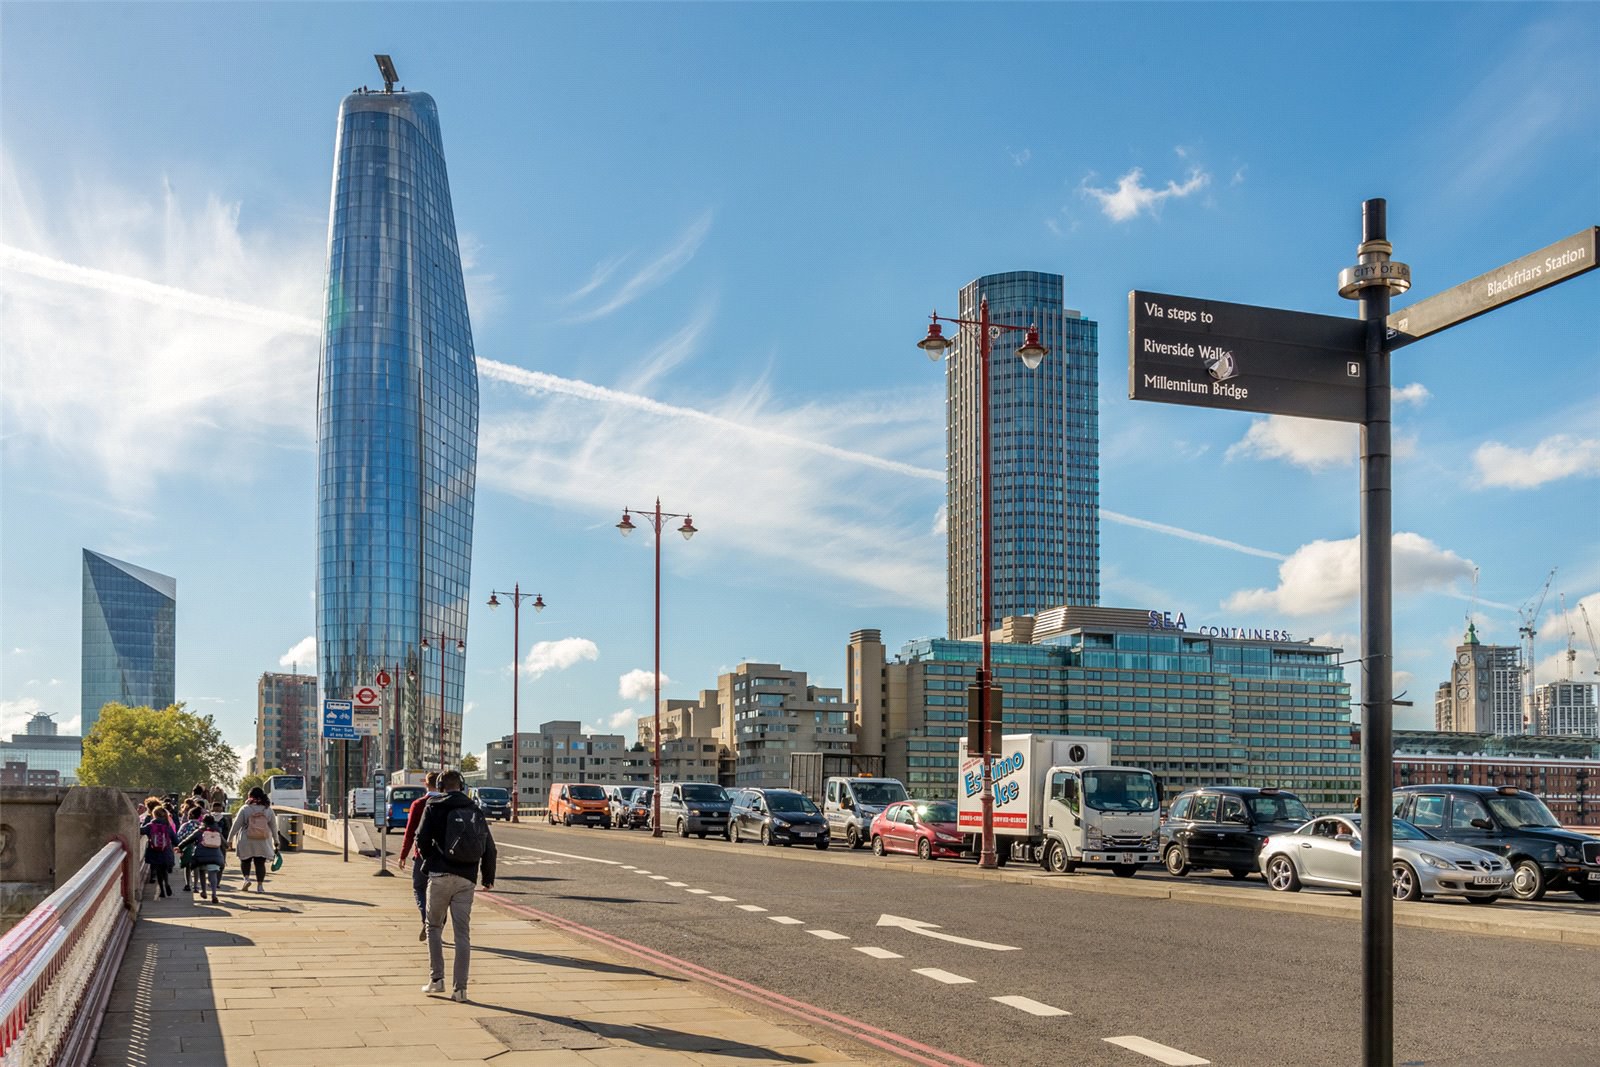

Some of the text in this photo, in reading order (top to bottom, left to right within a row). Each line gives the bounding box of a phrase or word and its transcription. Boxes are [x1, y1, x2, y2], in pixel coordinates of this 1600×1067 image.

[1353, 266, 1377, 278] CITY
[1381, 265, 1394, 274] OF
[1487, 247, 1585, 297] Blackfriars Station
[1144, 302, 1214, 324] Via steps to
[1144, 338, 1226, 360] Riverside Walk
[1144, 373, 1249, 400] Millennium Bridge
[1149, 610, 1288, 642] SEA CONTAINERS
[992, 780, 1020, 808] Ice
